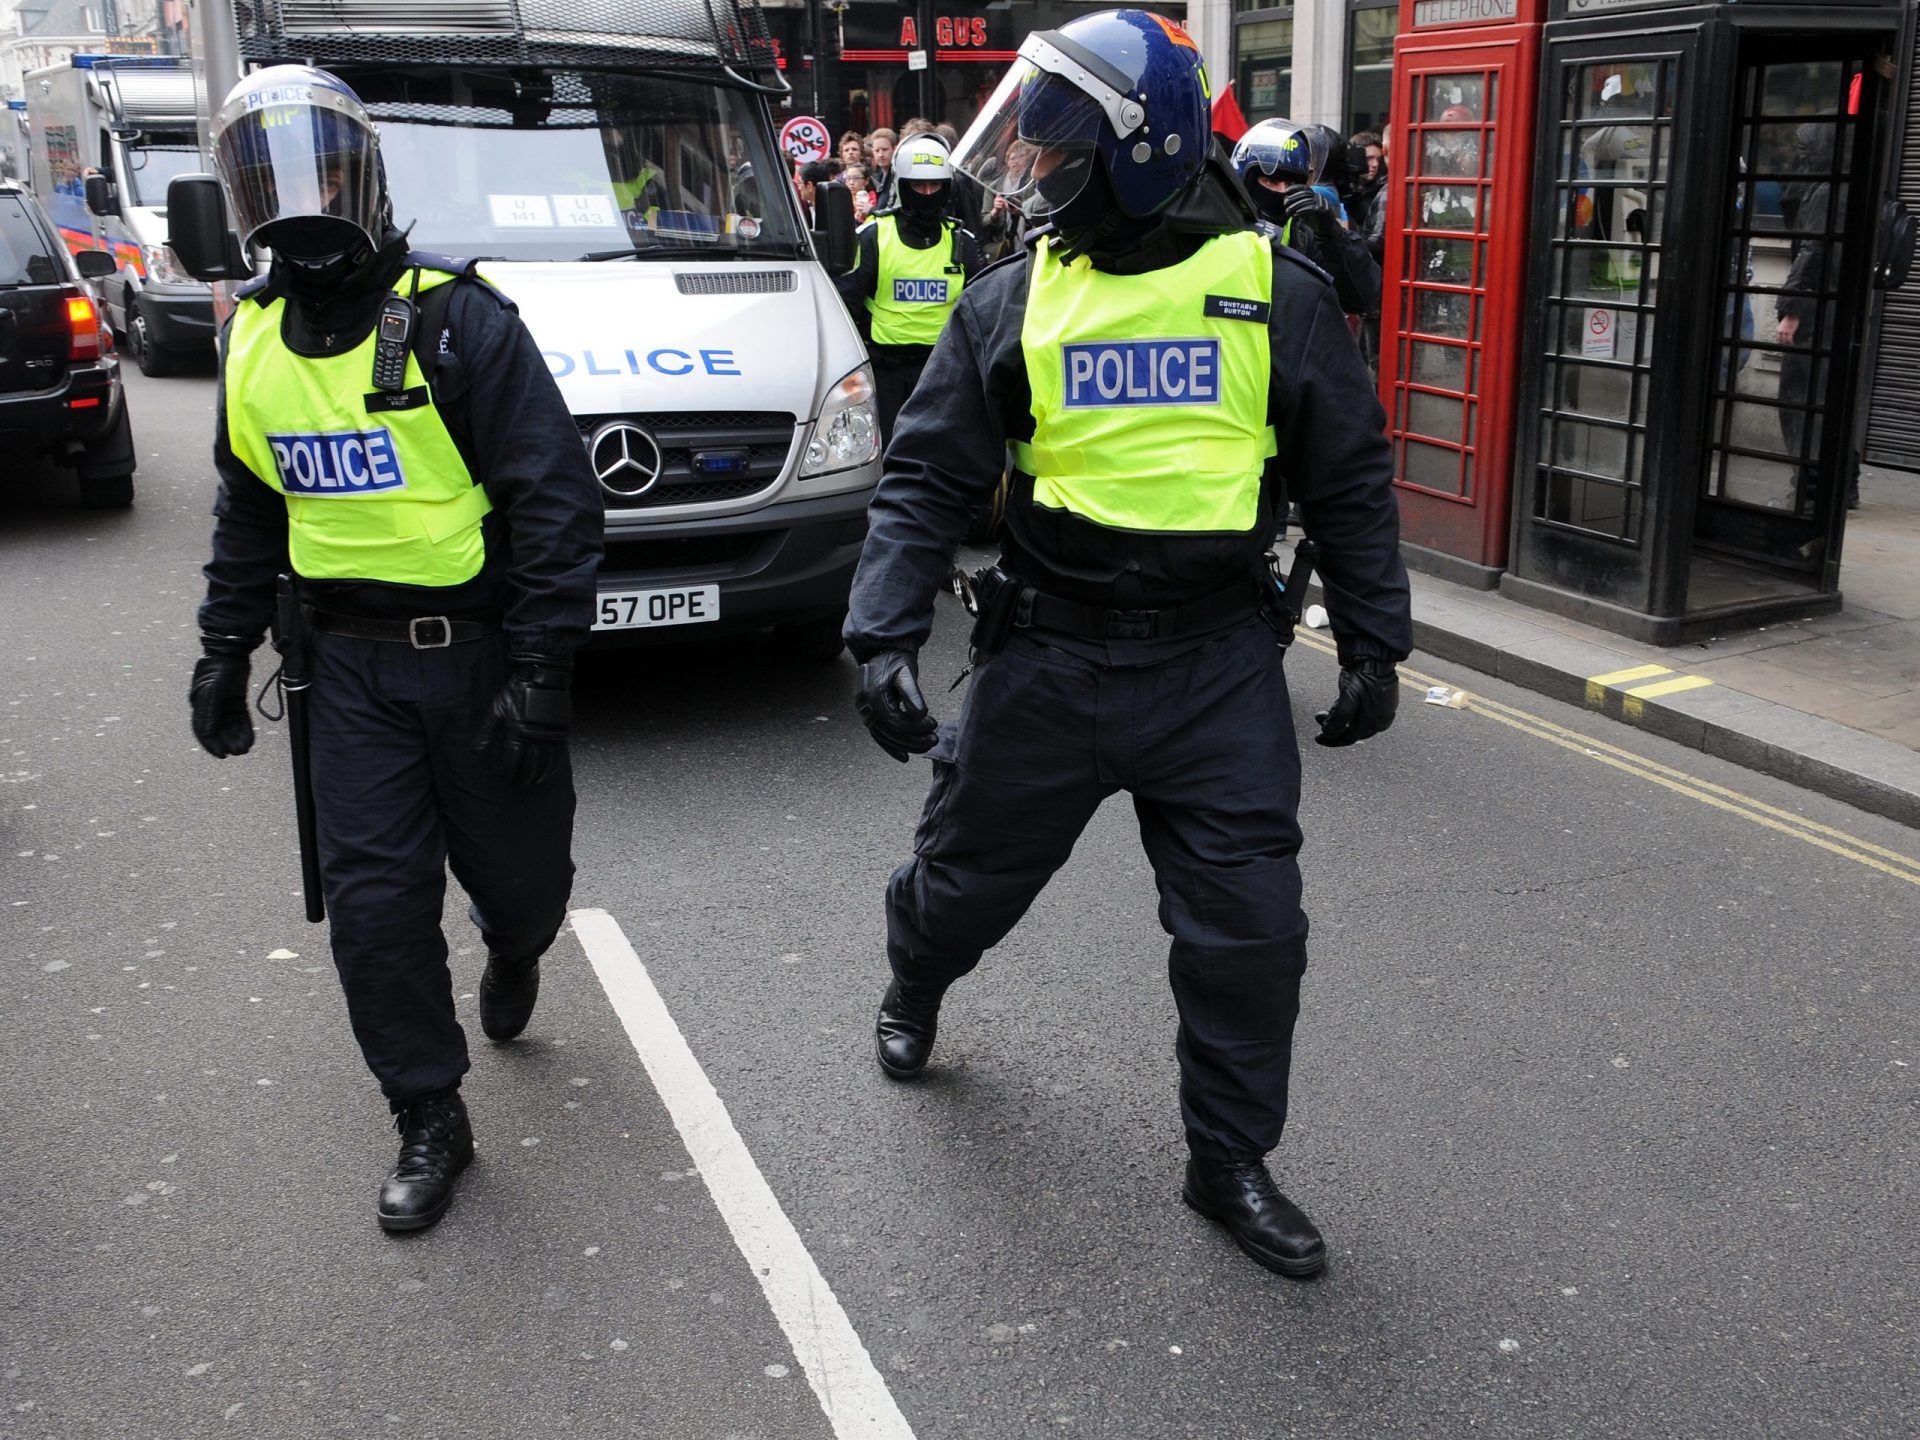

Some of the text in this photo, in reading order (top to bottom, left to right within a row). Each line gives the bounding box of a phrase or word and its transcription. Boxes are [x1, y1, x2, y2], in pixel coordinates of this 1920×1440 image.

[1419, 0, 1514, 22] TELEPHONE
[900, 16, 987, 46] AGUS
[789, 126, 813, 143] NO
[789, 137, 825, 157] CUTS
[912, 153, 929, 164] MP
[514, 199, 526, 209] U
[575, 198, 589, 209] U
[511, 211, 536, 222] 141
[569, 212, 604, 224] 143
[895, 280, 946, 301] POLICE
[1218, 300, 1258, 311] CONSTABLE
[541, 348, 742, 379] OLICE
[1070, 346, 1212, 400] POLICE
[271, 436, 397, 488] POLICE
[649, 590, 705, 621] OPE
